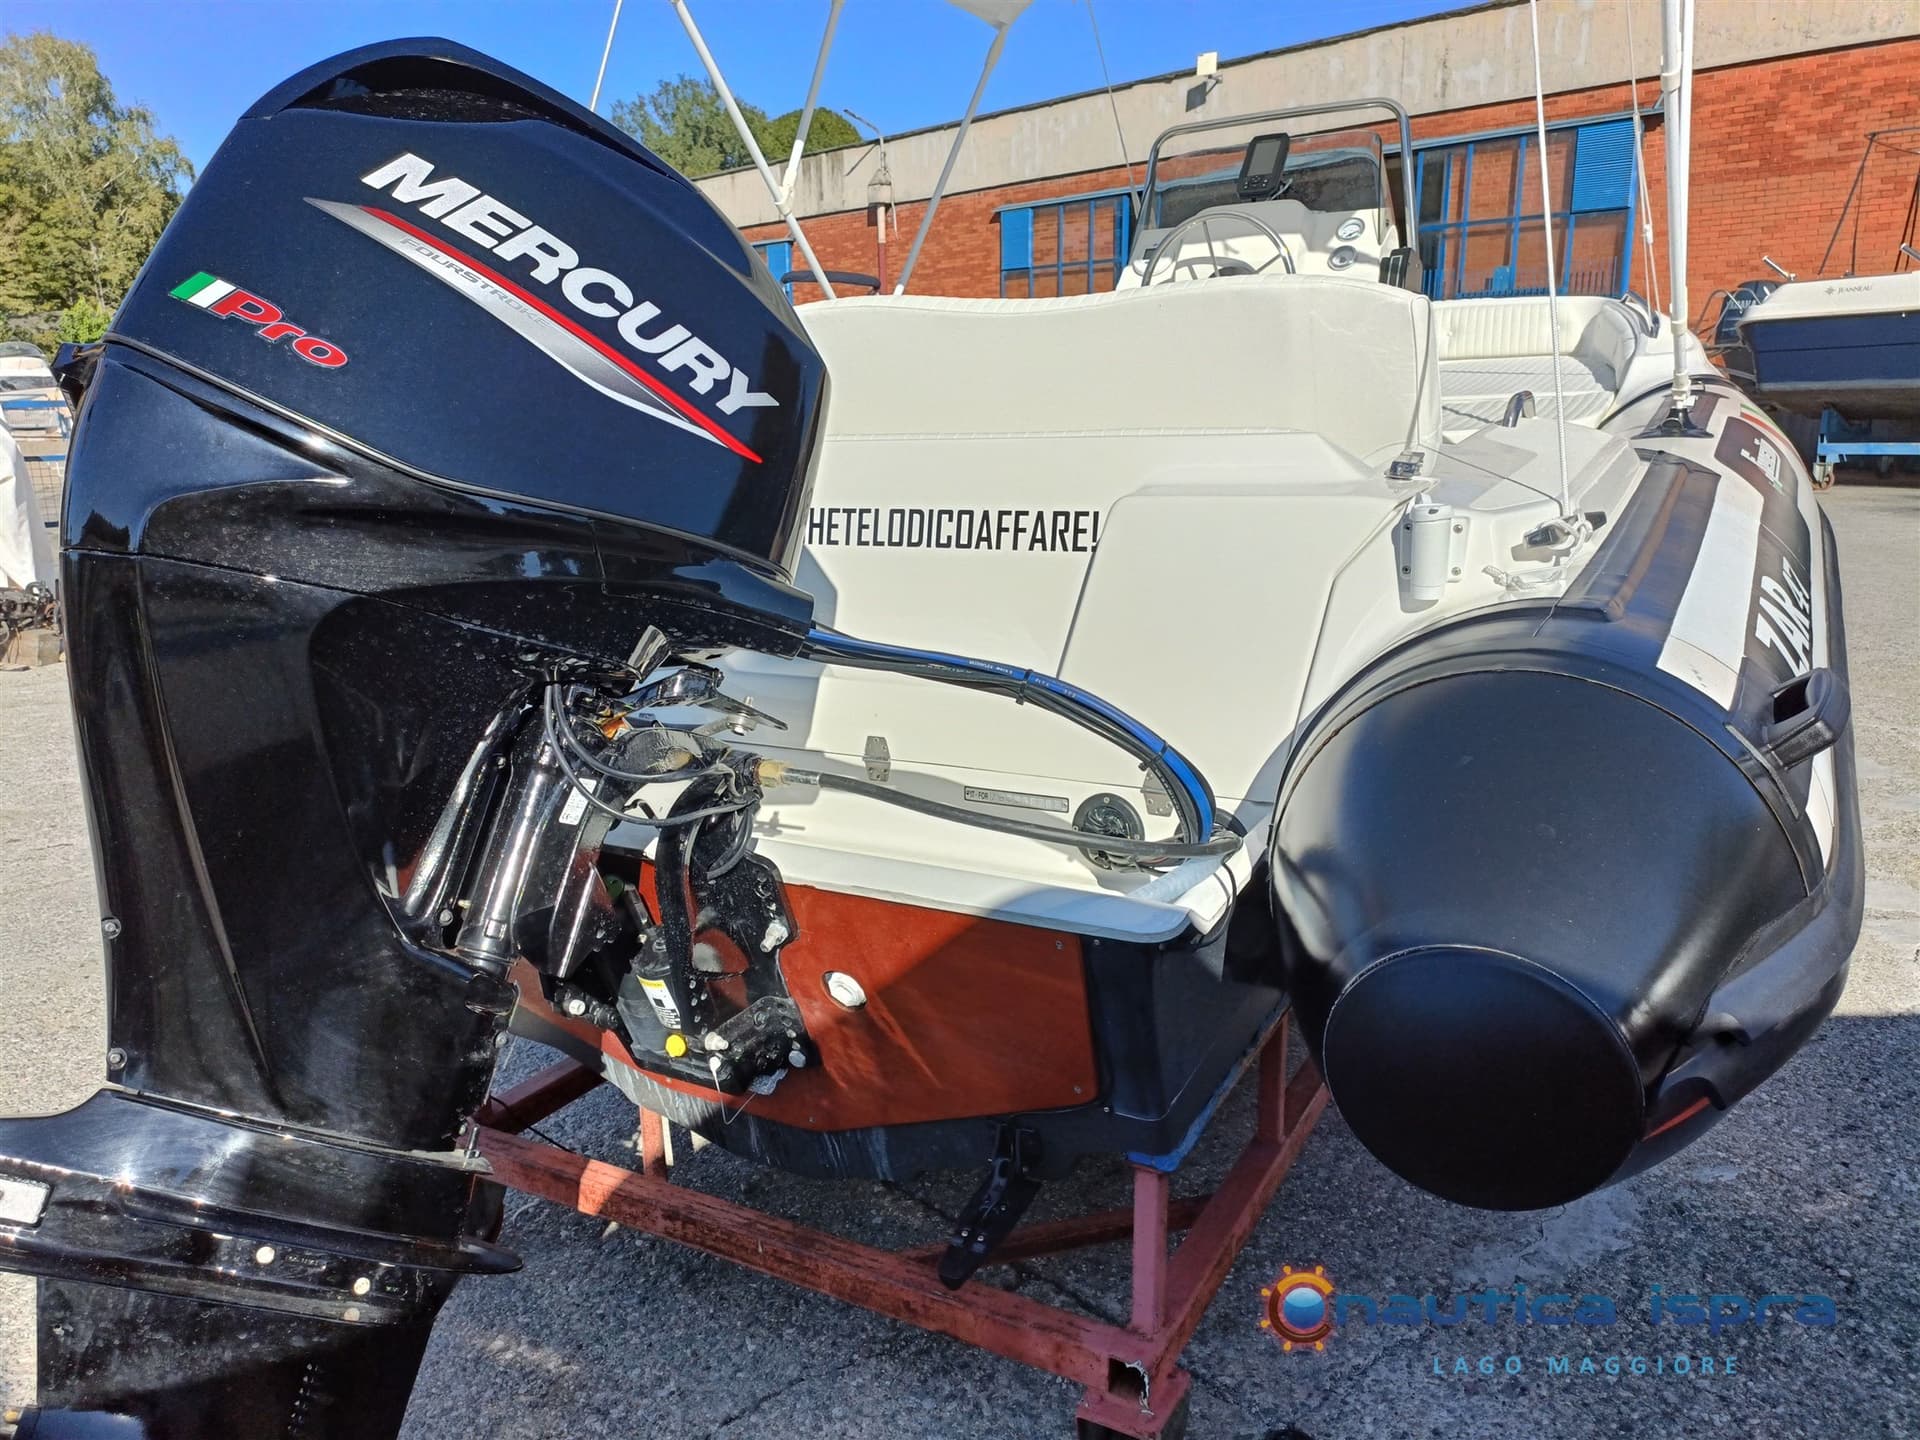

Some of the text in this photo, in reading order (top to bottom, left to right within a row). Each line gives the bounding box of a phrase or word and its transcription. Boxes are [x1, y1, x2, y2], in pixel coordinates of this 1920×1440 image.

[208, 288, 348, 367] Pro
[361, 153, 779, 416] MERCURY
[400, 236, 552, 329] FOURSTROKE
[1755, 575, 1810, 678] ZAR
